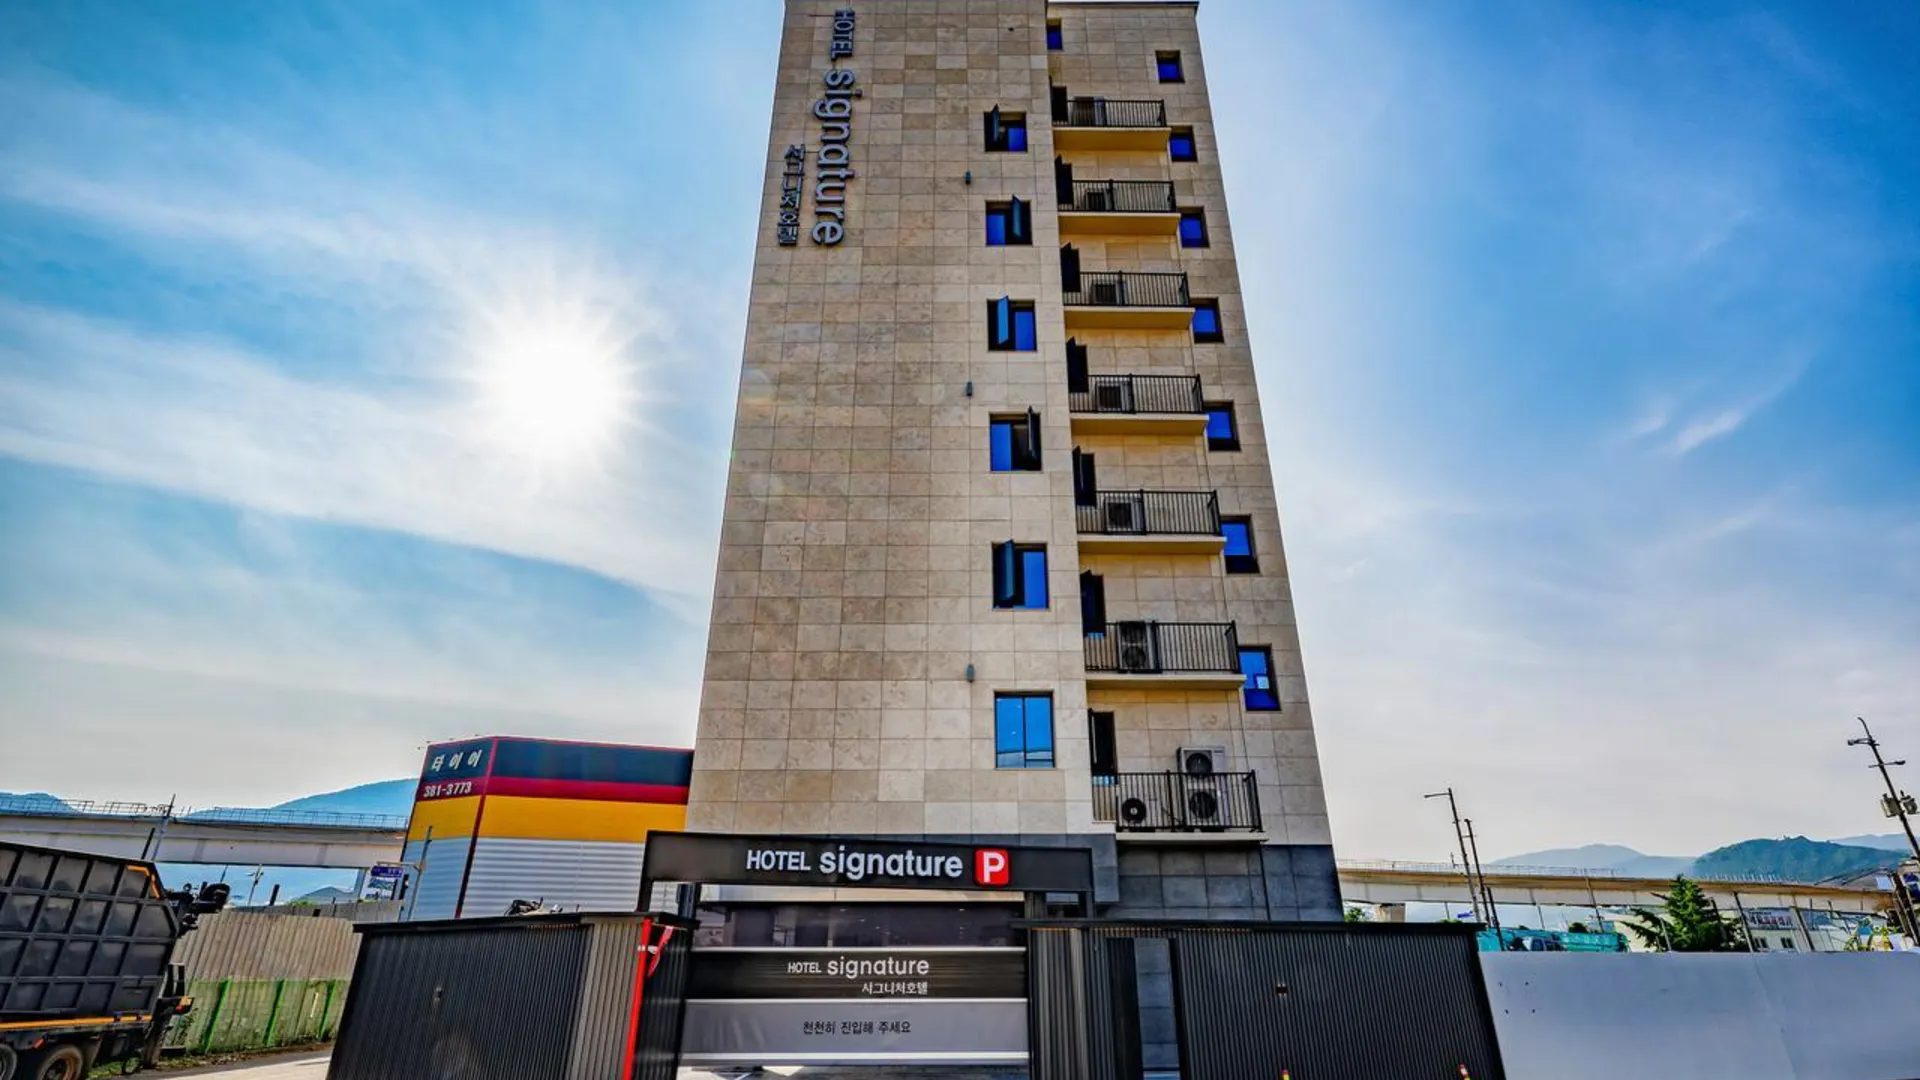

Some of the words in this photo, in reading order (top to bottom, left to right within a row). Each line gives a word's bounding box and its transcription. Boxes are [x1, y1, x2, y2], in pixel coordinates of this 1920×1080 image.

[831, 8, 855, 61] HOTEL
[811, 68, 863, 246] signature
[423, 781, 472, 798] 381-3773
[746, 849, 811, 871] HOTEL
[819, 845, 963, 880] signature
[983, 851, 1005, 882] P
[787, 961, 822, 973] HOTEL
[827, 955, 929, 979] signature
[861, 981, 928, 995] 시그니처호텔
[803, 1020, 836, 1035] 천천히
[841, 1020, 874, 1035] 진입해
[879, 1020, 911, 1034] 주세요
